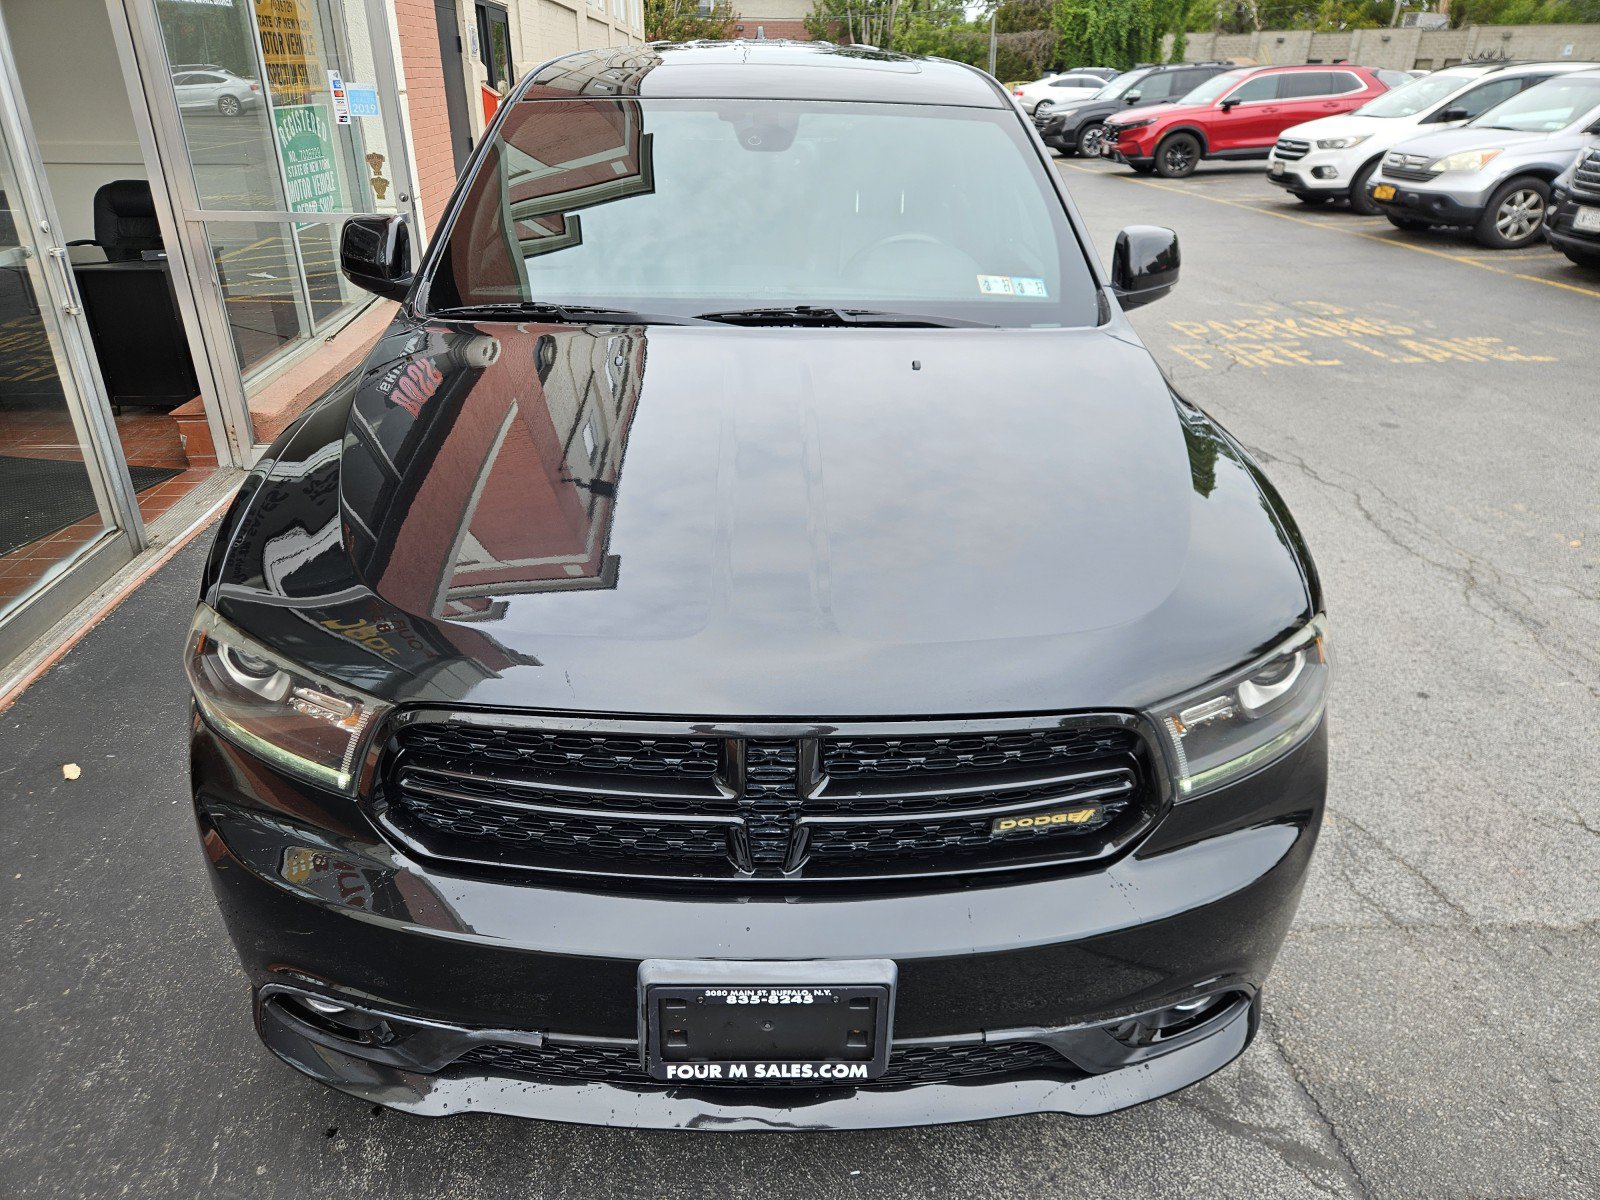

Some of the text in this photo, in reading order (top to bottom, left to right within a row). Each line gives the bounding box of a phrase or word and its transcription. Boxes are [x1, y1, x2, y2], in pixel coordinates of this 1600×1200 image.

[353, 104, 376, 113] 2019
[278, 109, 327, 149] REGISTERED
[288, 163, 303, 178] STATE
[309, 161, 320, 173] NEW
[288, 170, 337, 202] MOTOR VEHICLE
[1167, 336, 1560, 369] FIRE LANE
[1000, 810, 1083, 830] DODGE
[705, 989, 728, 997] 3080
[730, 989, 754, 997] MAIN
[757, 989, 768, 997] ST.
[814, 989, 832, 997] N.Y.
[726, 995, 814, 1004] 835-8245
[666, 1064, 869, 1079] FOUR M SALES.COM
